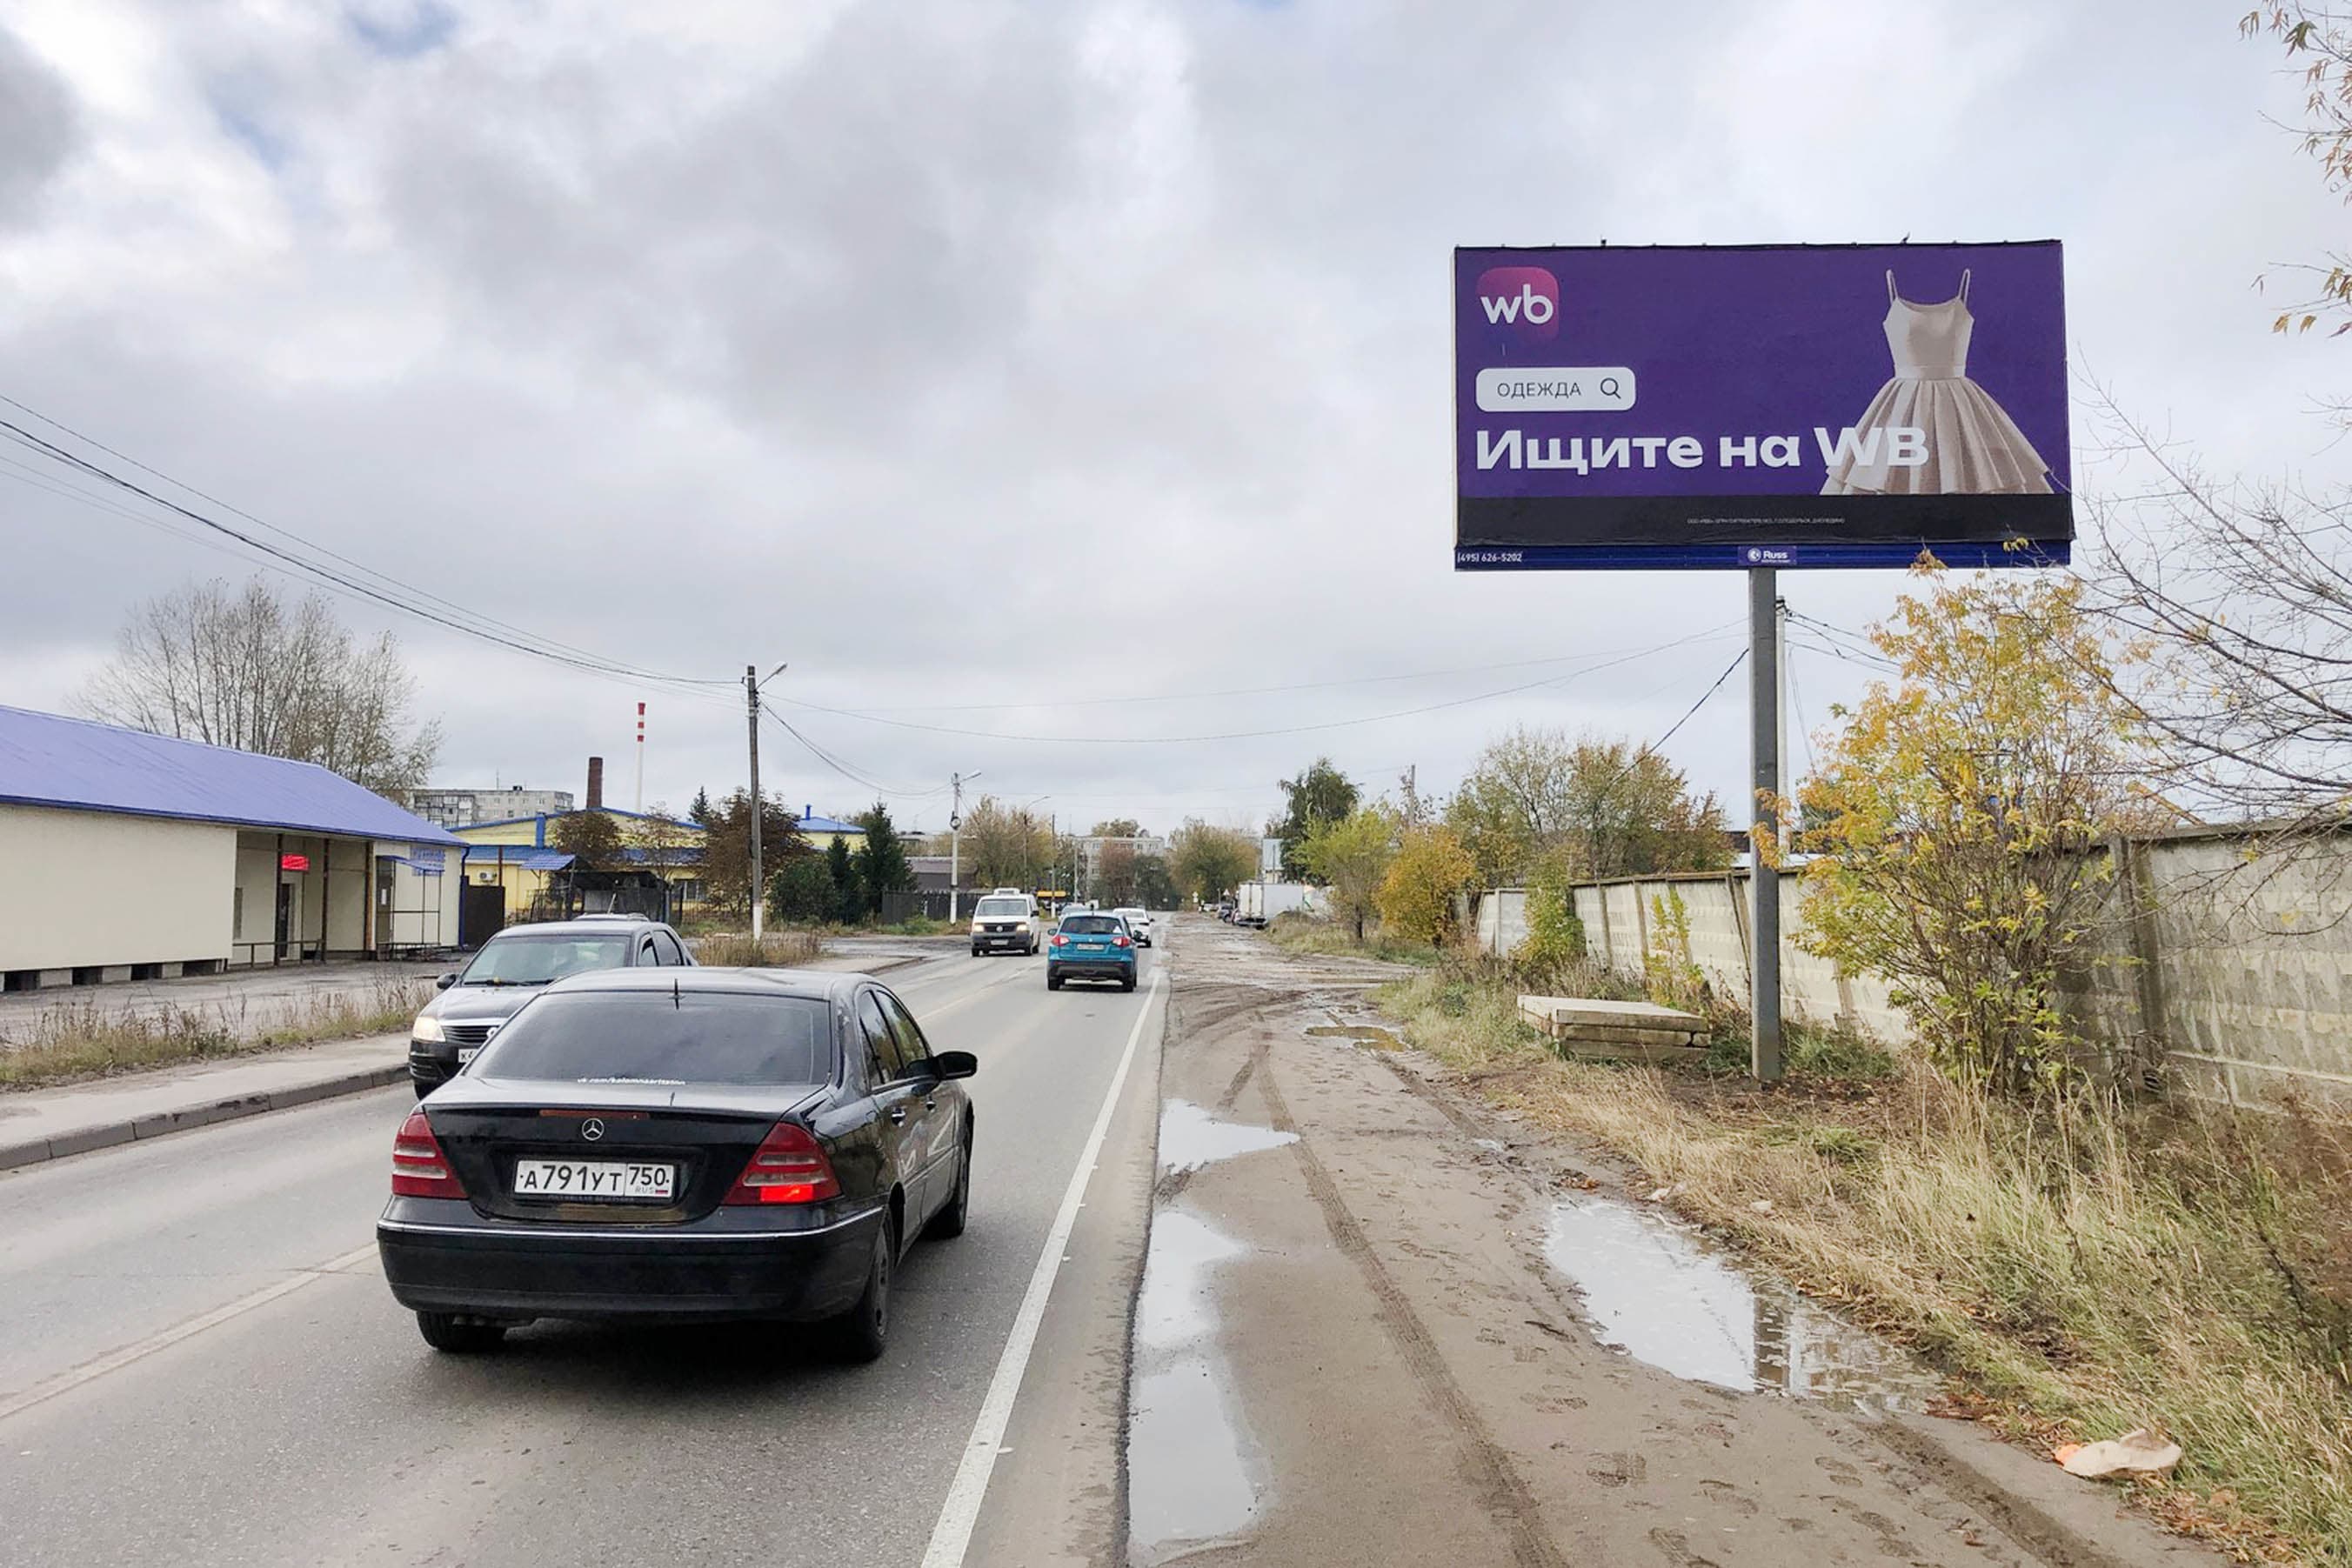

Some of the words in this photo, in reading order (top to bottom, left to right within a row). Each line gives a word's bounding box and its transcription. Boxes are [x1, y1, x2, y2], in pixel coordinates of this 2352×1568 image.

[1480, 283, 1554, 325] wb
[1496, 381, 1582, 400] ОДЕЖДА
[1476, 429, 1704, 476] Ищите
[1719, 435, 1801, 468] на
[1814, 426, 1930, 467] WB
[1762, 550, 1789, 560] Russ
[628, 1166, 666, 1186] 750
